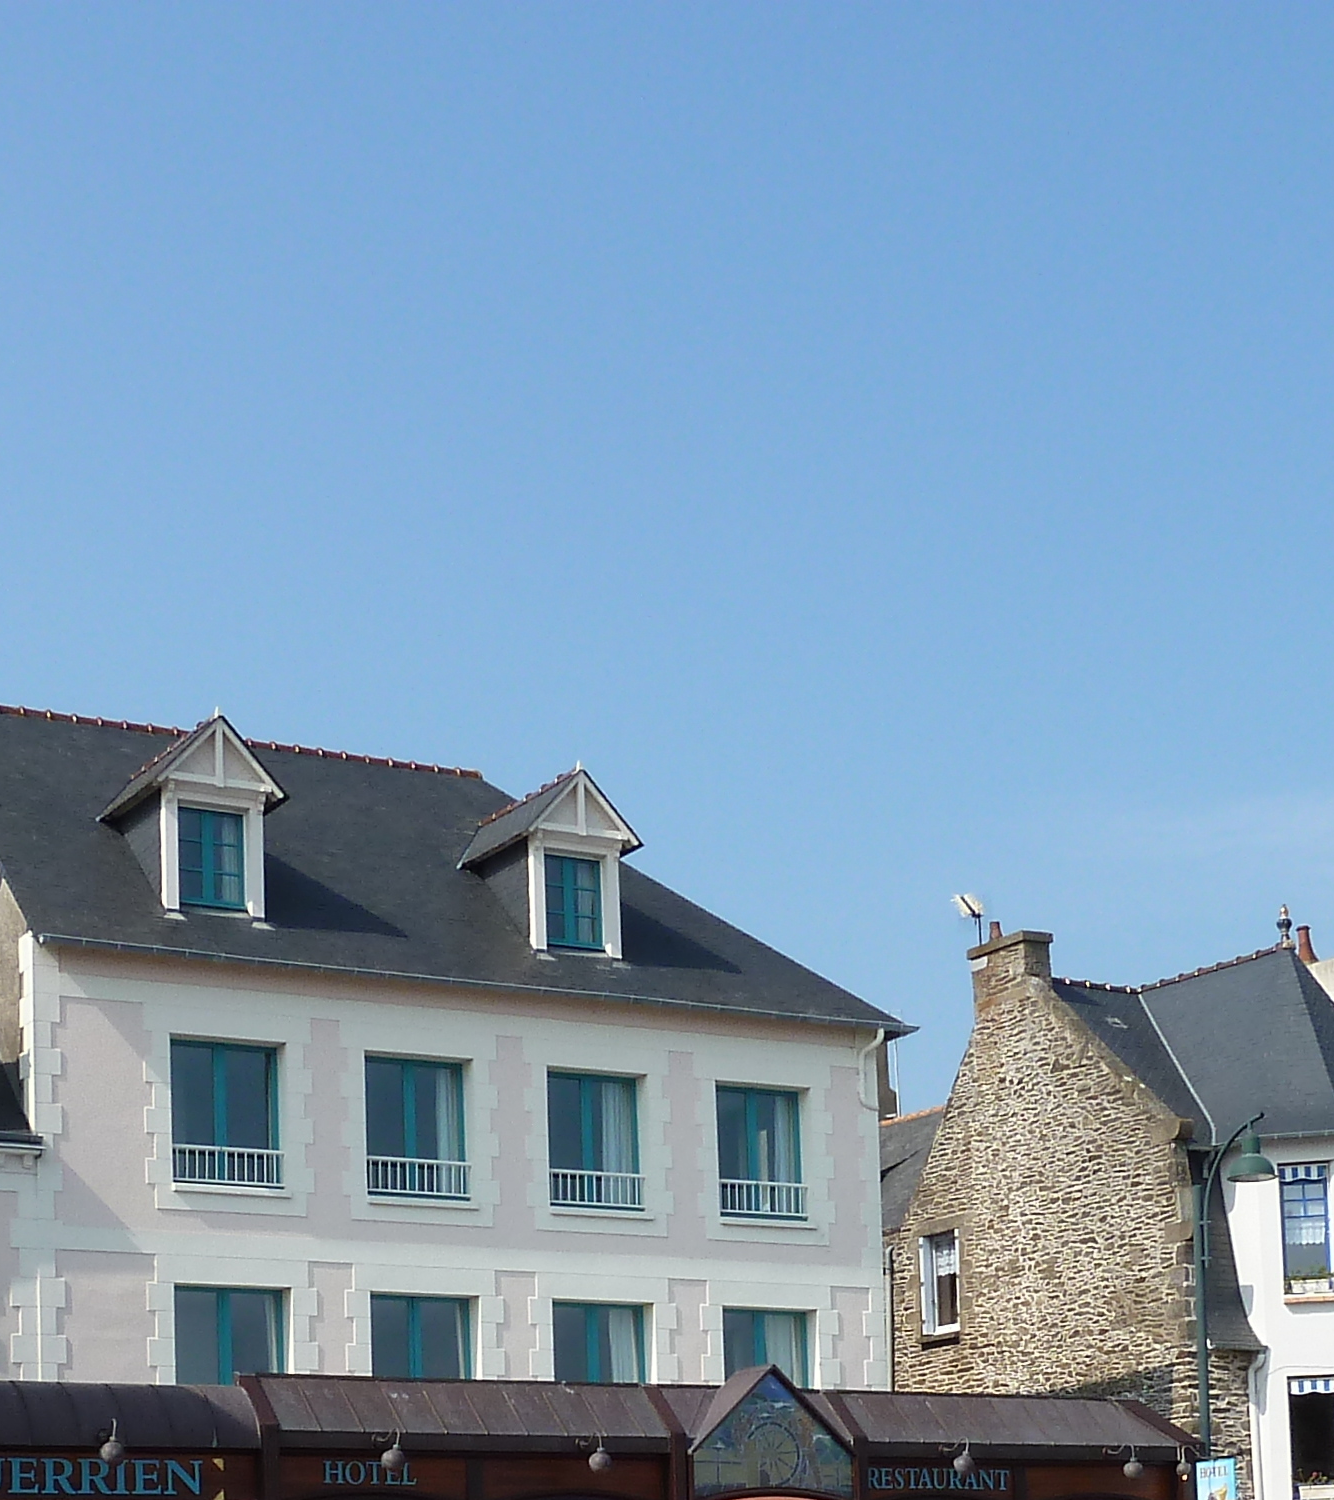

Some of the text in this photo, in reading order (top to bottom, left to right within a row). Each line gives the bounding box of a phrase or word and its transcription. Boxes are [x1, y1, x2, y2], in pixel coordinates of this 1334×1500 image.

[323, 1460, 418, 1486] HOTEL
[868, 1467, 1010, 1491] RESTAURANT
[1199, 1465, 1229, 1479] HOTEL
